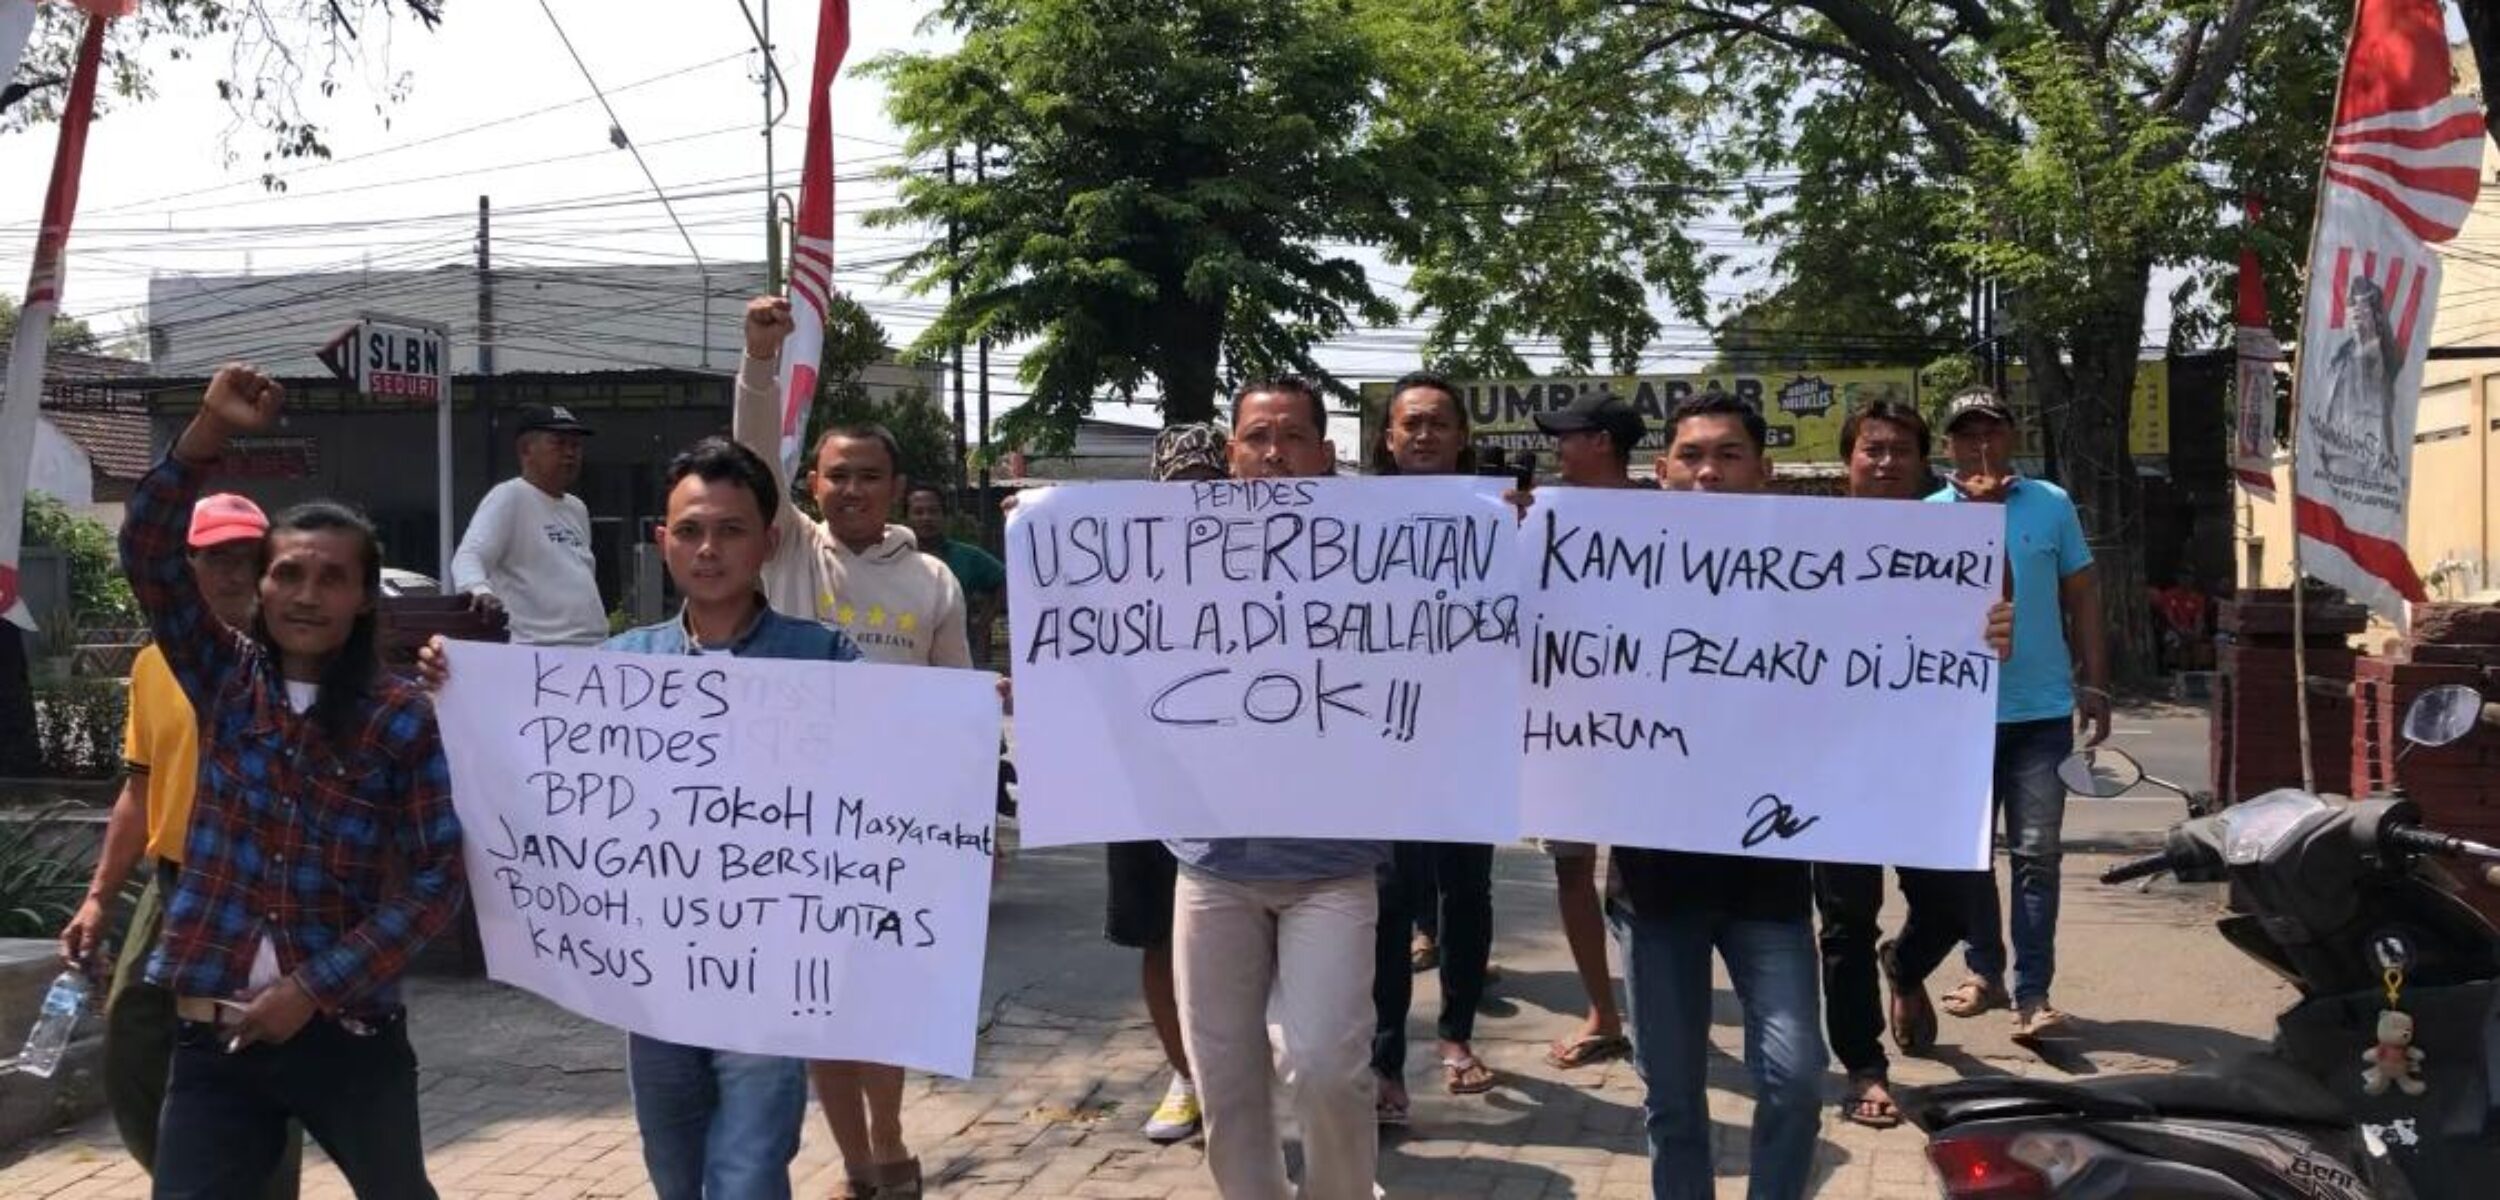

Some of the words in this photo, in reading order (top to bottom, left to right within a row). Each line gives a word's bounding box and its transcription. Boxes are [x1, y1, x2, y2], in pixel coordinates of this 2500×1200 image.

[369, 333, 439, 376] SLBN
[372, 376, 438, 396] SEDURI
[1196, 481, 1317, 512] PEMDES
[1184, 511, 1500, 594] PERBUATAN
[1681, 540, 1846, 597] WARGA
[534, 651, 730, 720] KADES
[1660, 627, 1829, 686] PELAKU
[486, 814, 702, 880] JANGAN
[662, 895, 781, 930] USUT
[527, 918, 653, 988] KASUS
